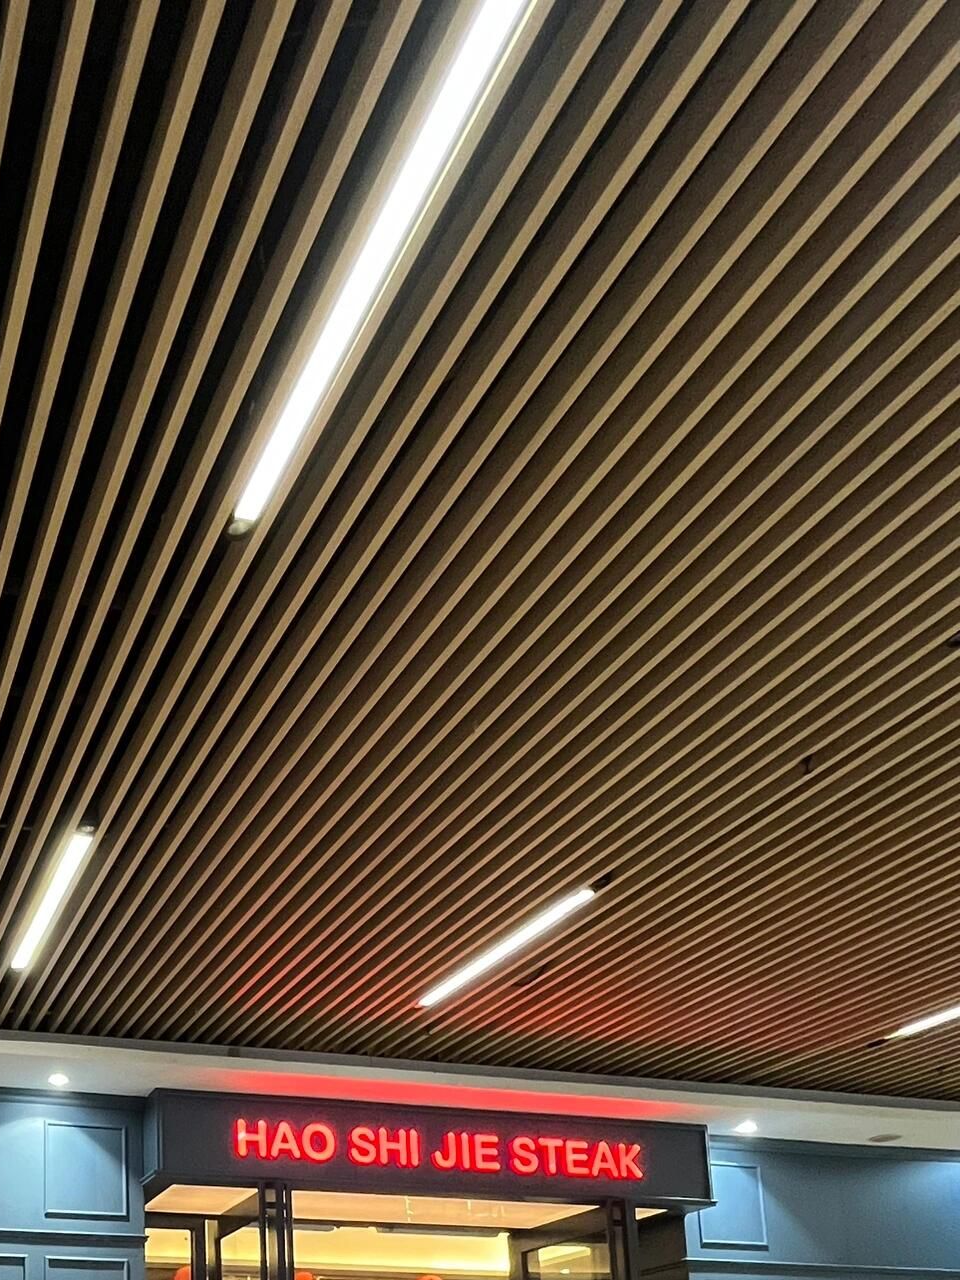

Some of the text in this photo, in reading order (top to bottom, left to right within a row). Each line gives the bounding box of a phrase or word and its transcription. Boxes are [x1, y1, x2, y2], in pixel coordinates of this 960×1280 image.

[235, 1118, 644, 1180] HAO SHI JIE STEAK
